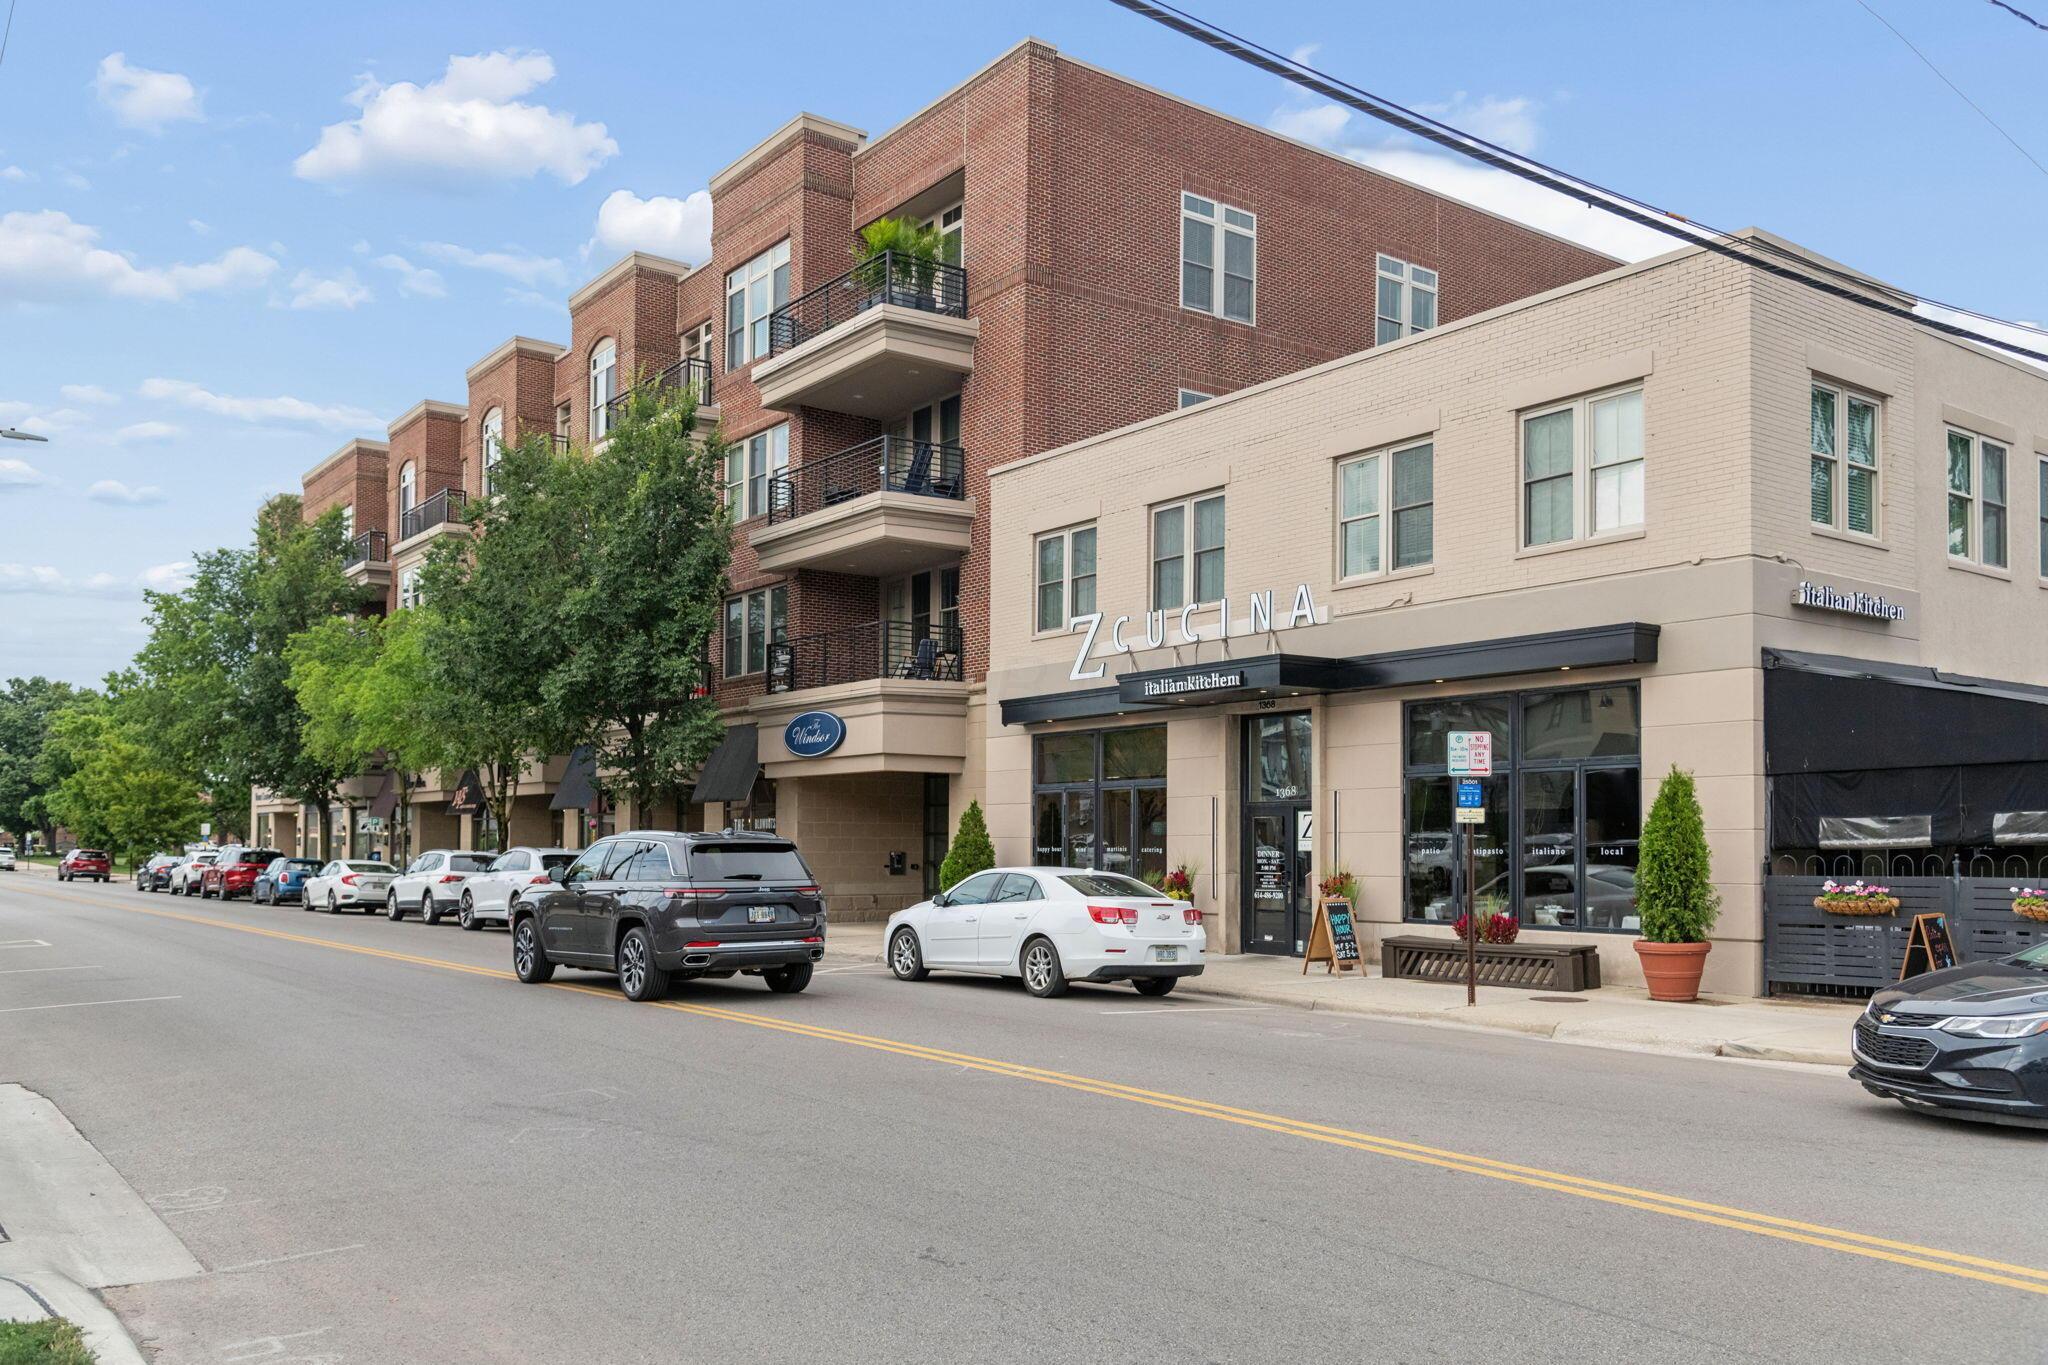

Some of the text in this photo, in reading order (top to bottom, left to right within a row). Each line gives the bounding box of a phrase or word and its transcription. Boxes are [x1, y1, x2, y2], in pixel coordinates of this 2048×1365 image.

[1069, 584, 1317, 680] Z CUCINA
[1258, 700, 1276, 709] 1368
[792, 727, 831, 745] Windsor
[1470, 743, 1489, 751] STOPPING
[1276, 785, 1297, 799] 1368
[1141, 846, 1163, 854] catering
[1421, 847, 1441, 856] patio
[1472, 847, 1504, 856] tipasto
[1532, 846, 1566, 855] italiano
[1600, 846, 1624, 855] local
[1330, 913, 1351, 925] HAPPY
[1334, 924, 1353, 935] HOUR
